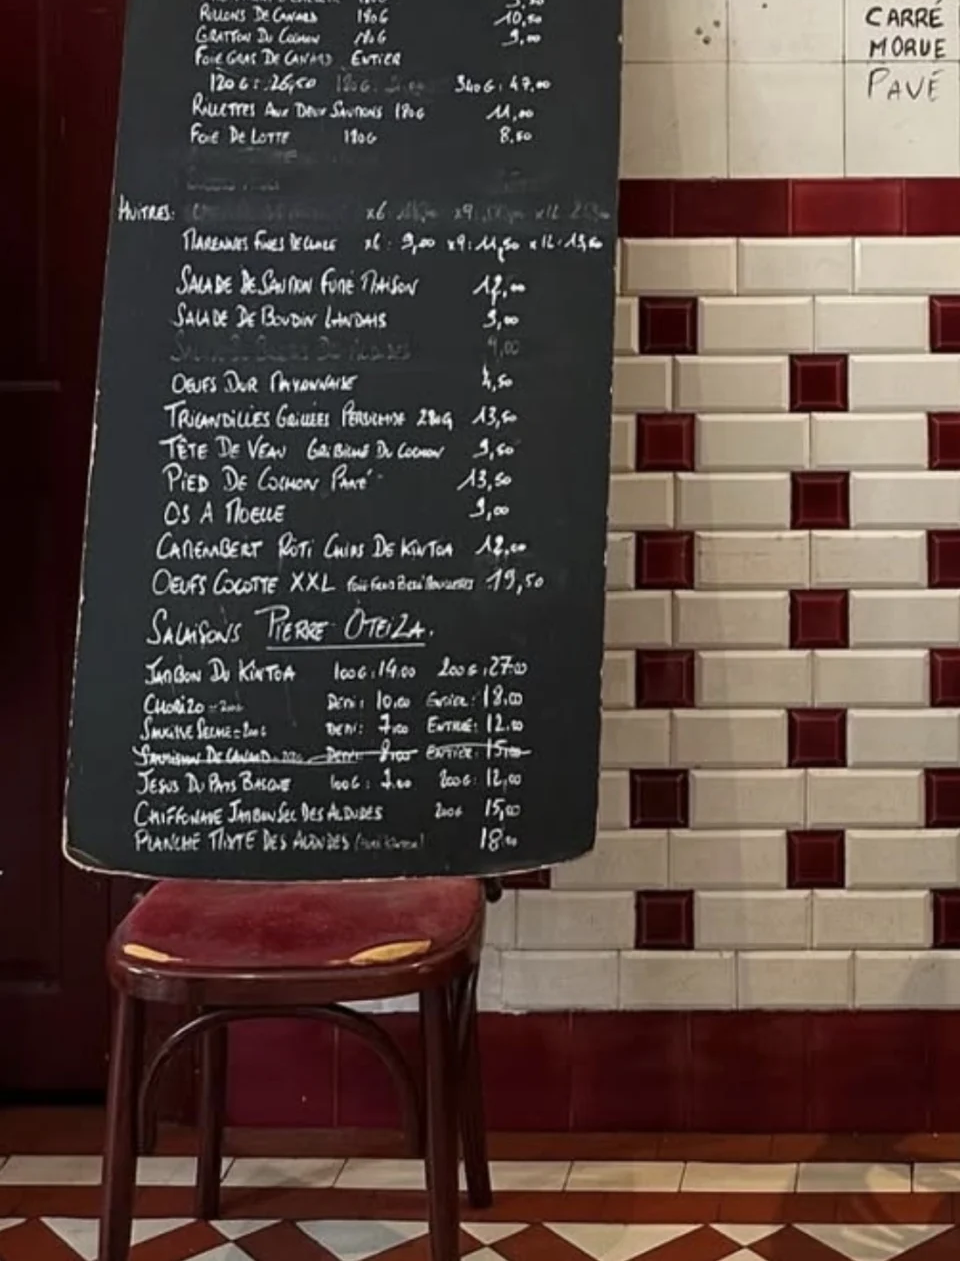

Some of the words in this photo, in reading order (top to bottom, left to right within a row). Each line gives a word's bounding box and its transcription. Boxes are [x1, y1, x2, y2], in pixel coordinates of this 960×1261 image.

[868, 38, 947, 59] MORUE
[867, 68, 945, 102] PAVÉ
[176, 264, 233, 296] SALADE
[240, 269, 257, 294] DE
[173, 302, 229, 327] SALADE
[236, 304, 257, 328] DE
[215, 436, 240, 459] DE
[222, 465, 248, 491] DE
[290, 571, 335, 592] XXL
